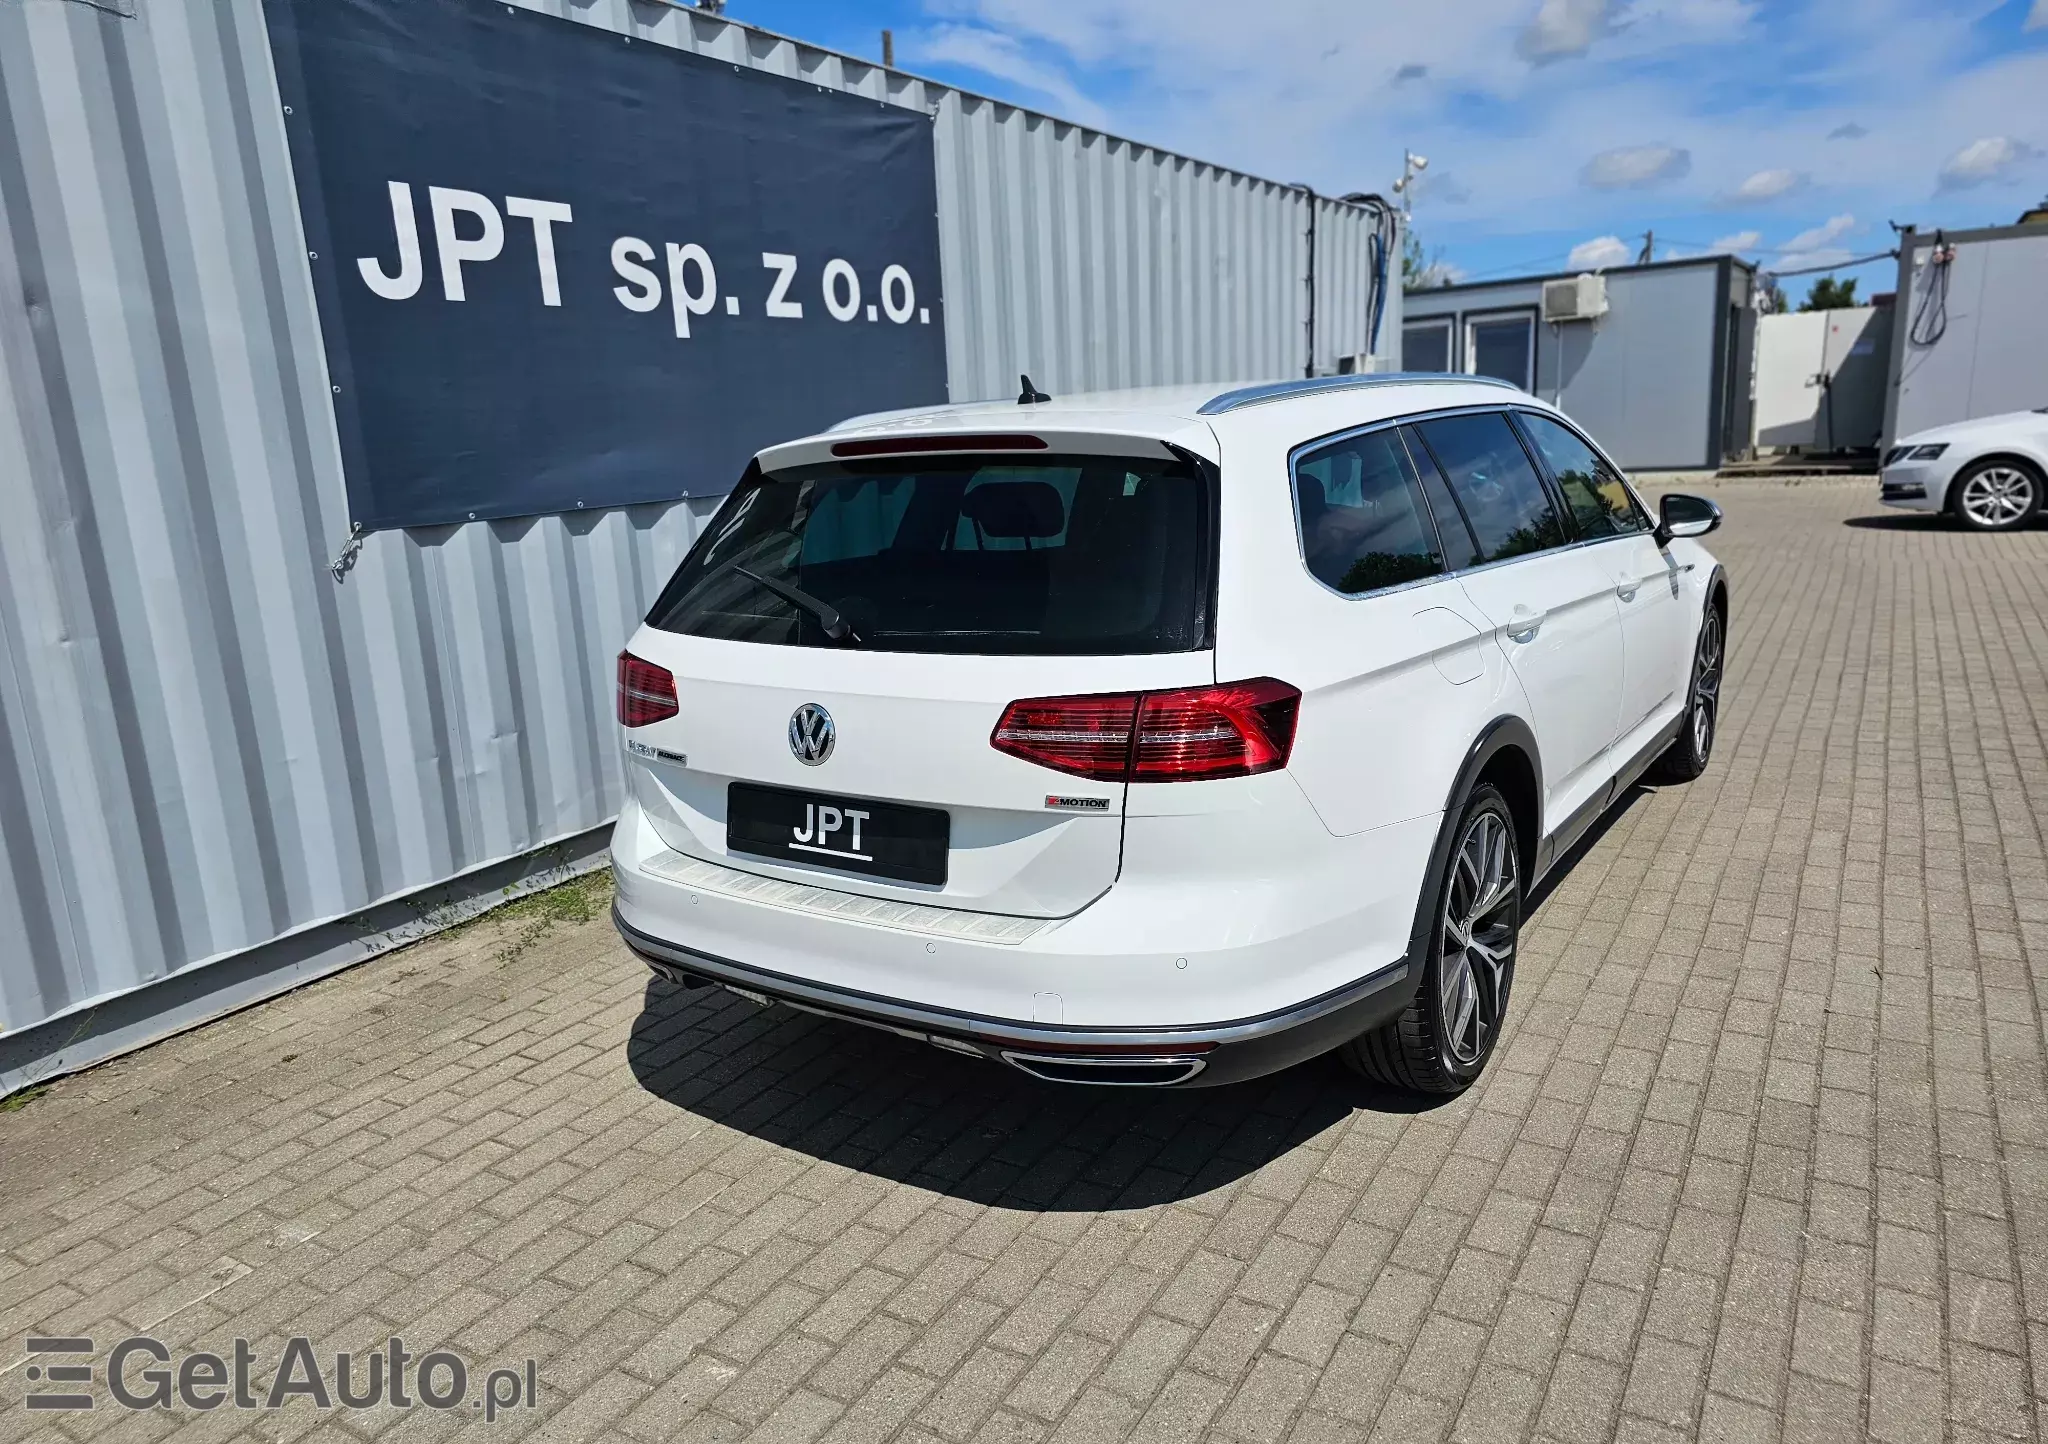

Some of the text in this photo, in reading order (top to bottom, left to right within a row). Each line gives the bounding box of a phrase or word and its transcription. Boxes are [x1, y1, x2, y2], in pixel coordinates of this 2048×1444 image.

[357, 180, 931, 339] JPT sp. z o.o.
[793, 803, 870, 850] JPT
